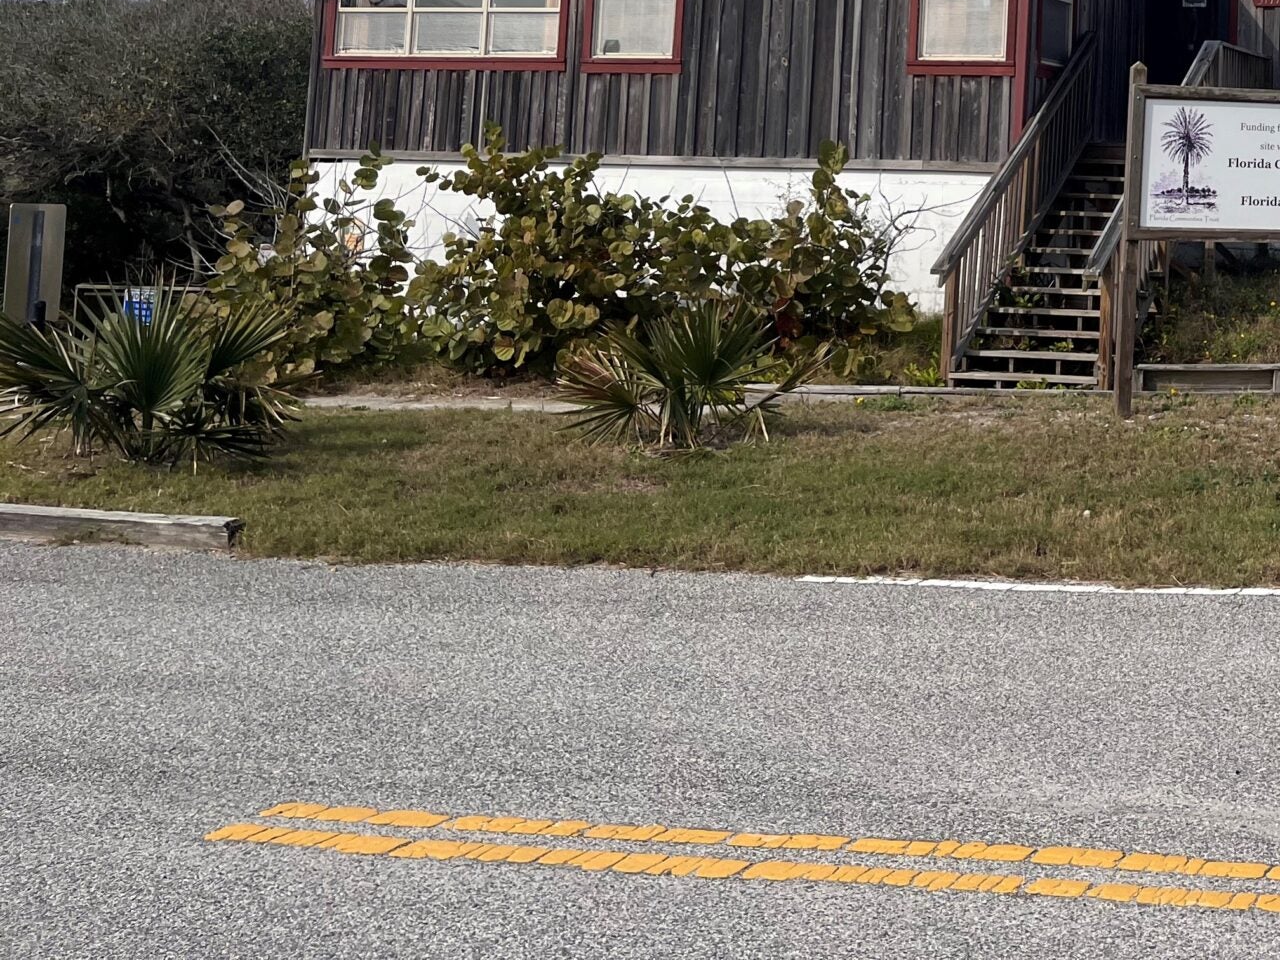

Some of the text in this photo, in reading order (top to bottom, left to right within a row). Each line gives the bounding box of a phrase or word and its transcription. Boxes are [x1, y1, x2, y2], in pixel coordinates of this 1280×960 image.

[1240, 122, 1275, 134] Funding
[1259, 142, 1275, 151] site
[1227, 157, 1272, 169] Florida
